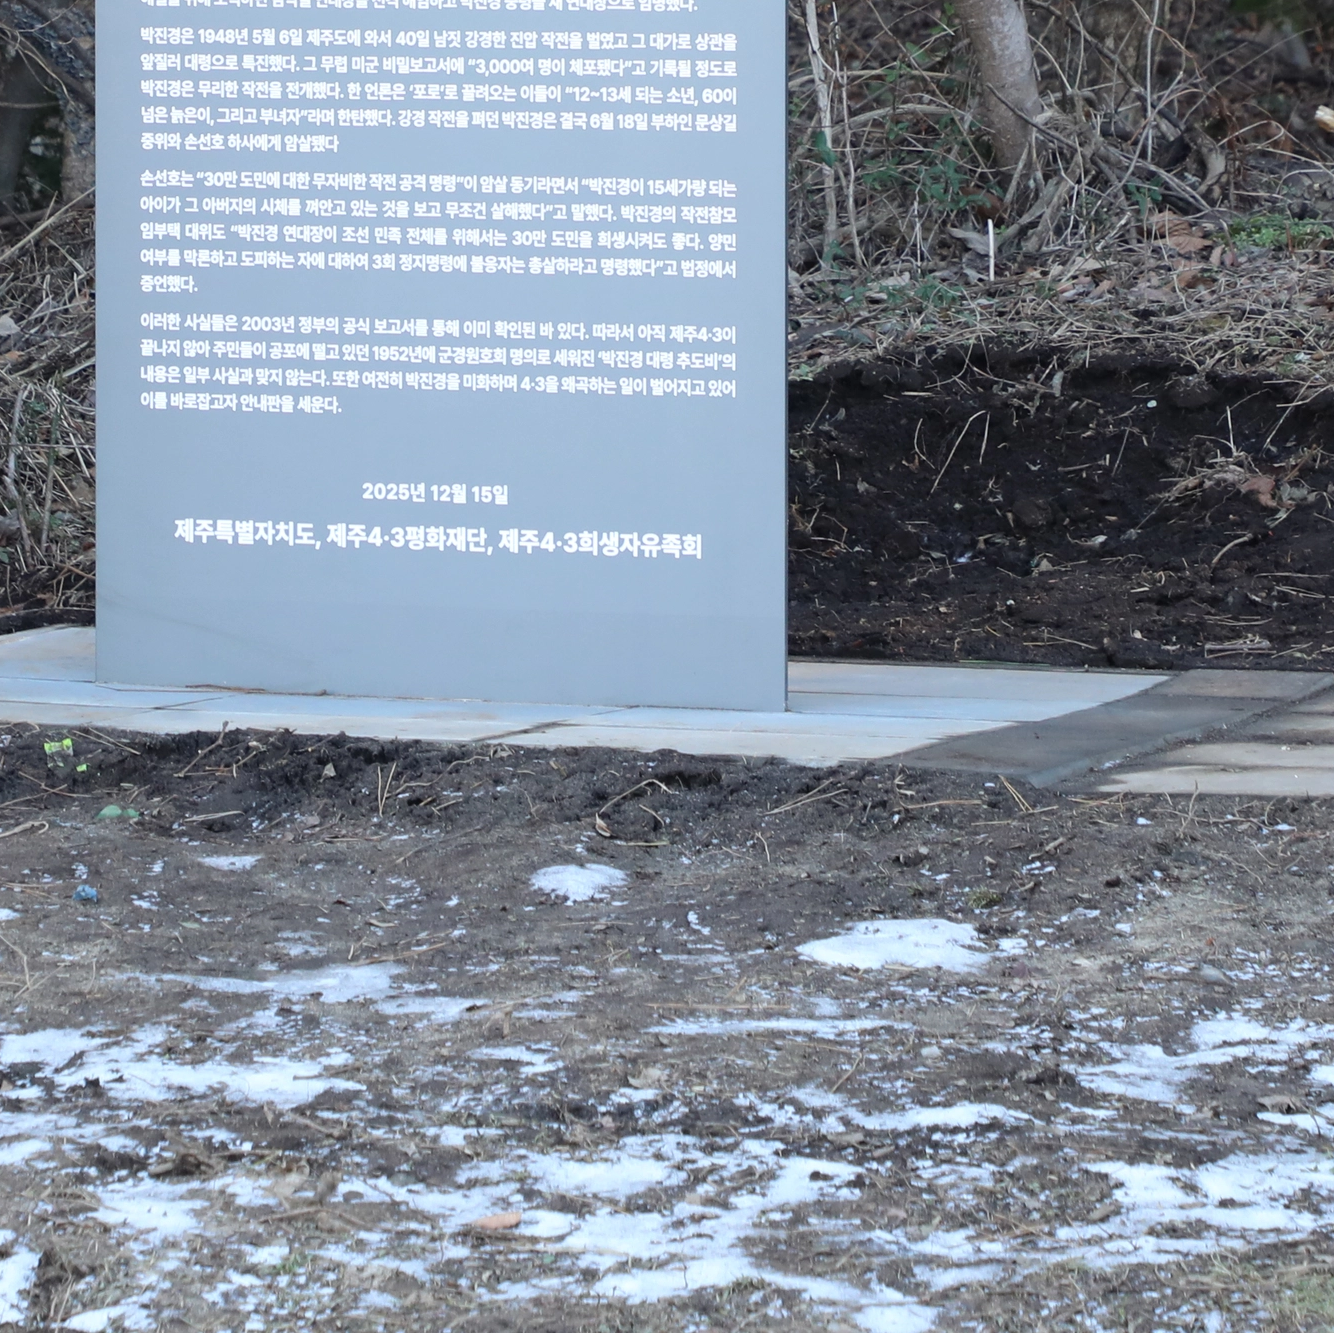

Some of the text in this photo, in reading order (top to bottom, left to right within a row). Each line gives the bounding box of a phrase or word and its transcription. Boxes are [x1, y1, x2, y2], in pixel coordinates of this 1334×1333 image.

[140, 132, 339, 152] 중위와 손선호 하사에게 암살됐다
[140, 195, 181, 213] 아이가
[184, 197, 199, 212] 그
[202, 196, 256, 215] 아버지의
[260, 197, 301, 216] 시체를
[305, 198, 346, 216] 껴안고
[350, 199, 378, 217] 있는
[382, 199, 409, 218] 것을
[413, 201, 441, 217] 보고
[445, 201, 486, 219] 무조건
[571, 203, 617, 222] 말했다.
[620, 204, 676, 223] 박진경의
[680, 205, 737, 224] 작전참모
[140, 248, 181, 266] 여부를
[183, 249, 238, 267] 막론하고
[240, 250, 295, 268] 도피하는
[297, 251, 325, 269] 자에
[327, 251, 368, 270] 대하여
[371, 253, 395, 271] 3회
[399, 253, 467, 272] 정지명령에
[469, 255, 525, 273] 불응자는
[528, 256, 597, 275] 총살하라고
[681, 259, 736, 278] 법정에서
[139, 274, 198, 293] 증언했다.
[139, 339, 180, 357] 끝나지
[183, 339, 210, 357] 않아
[212, 340, 266, 359] 주민들이
[269, 342, 309, 360] 공포에
[312, 342, 340, 360] 떨고
[341, 343, 369, 361] 있던
[371, 345, 435, 363] 1952년에
[437, 346, 506, 365] 군경원호회
[509, 347, 551, 366] 명의로
[553, 348, 594, 367] 세워진
[645, 350, 673, 369] 대령
[140, 391, 342, 414] 이를 바로잡고자 안내판을 세운다.
[362, 482, 508, 505] 2025년 12월 15일
[174, 518, 701, 559] 제주특별자치도, 제주4·3평화재단, 제주4·3희생자유족회
